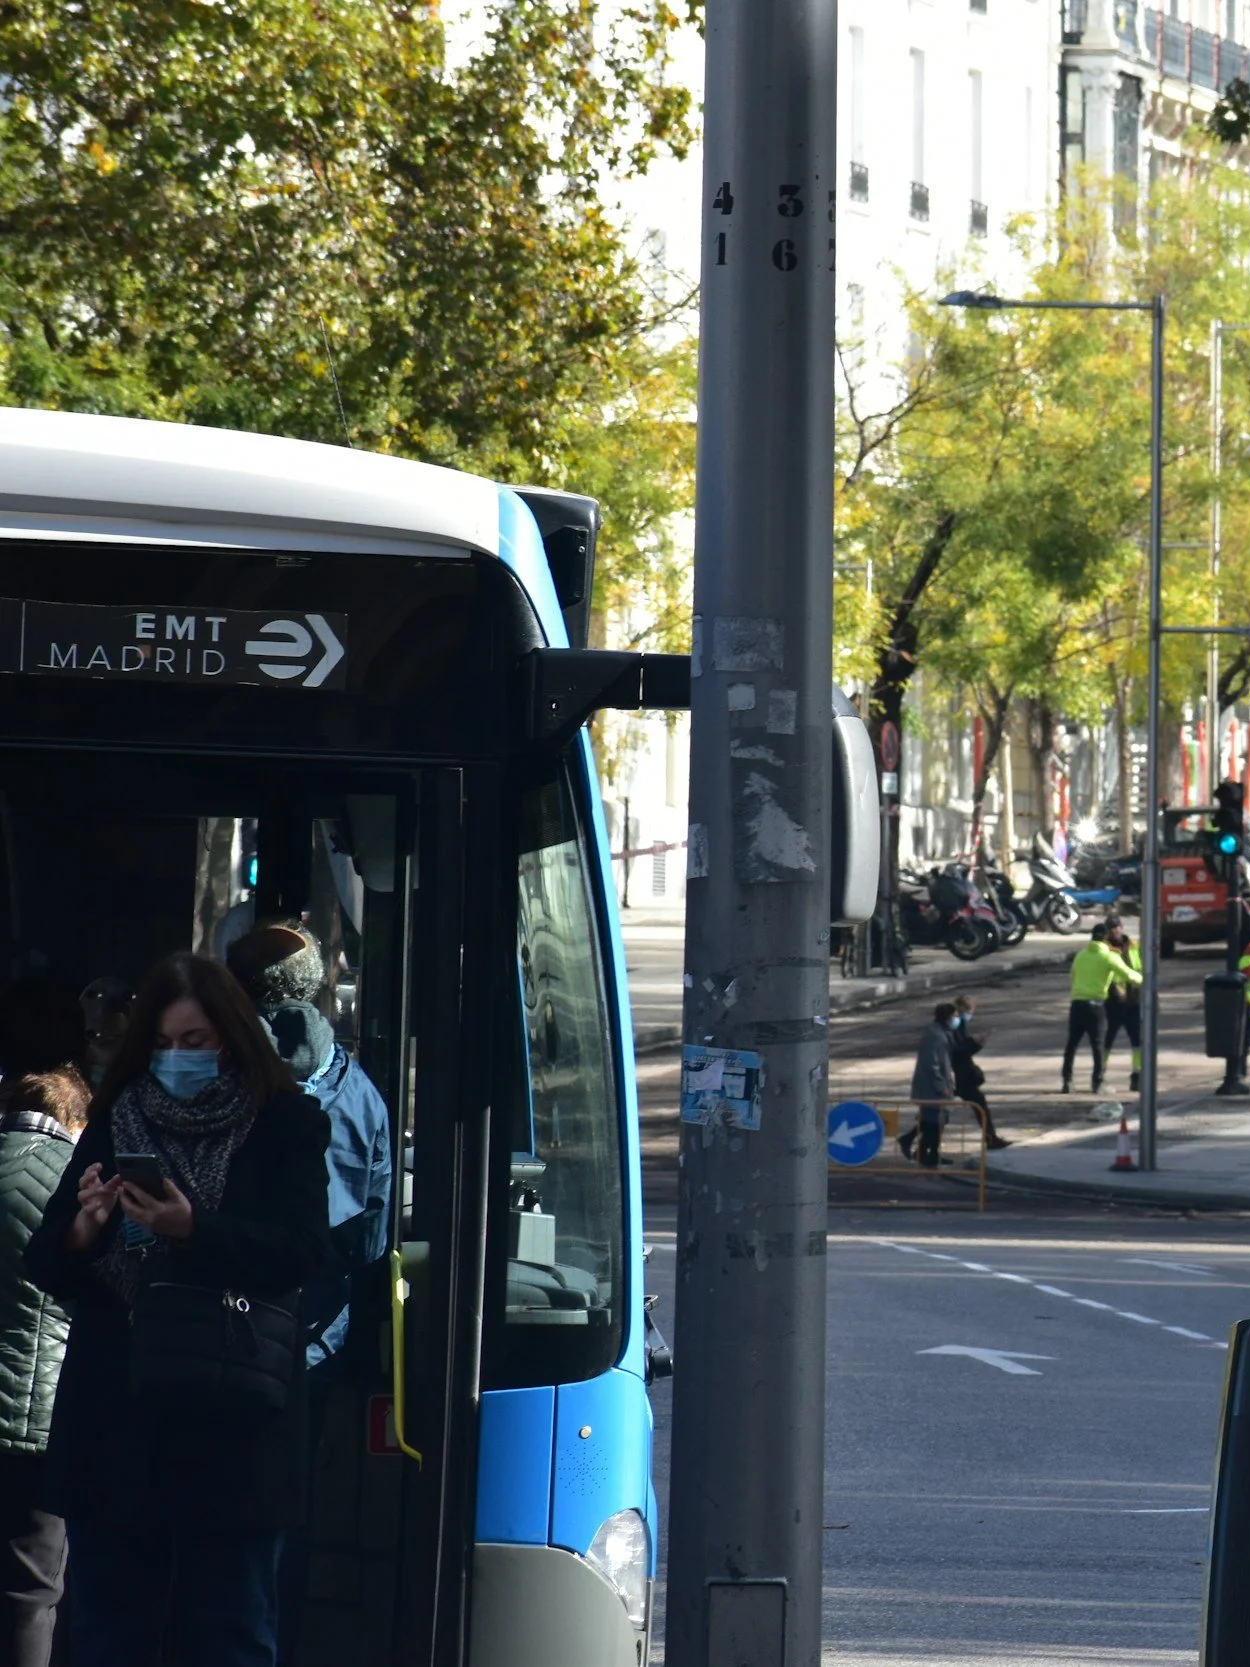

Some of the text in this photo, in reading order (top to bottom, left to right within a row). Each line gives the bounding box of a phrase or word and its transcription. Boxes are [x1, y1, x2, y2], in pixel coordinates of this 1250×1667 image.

[712, 181, 734, 215] 4
[777, 184, 804, 217] 3
[714, 232, 727, 266] 1
[771, 238, 798, 272] 6
[135, 612, 227, 642] EMT
[50, 642, 226, 676] MADRID
